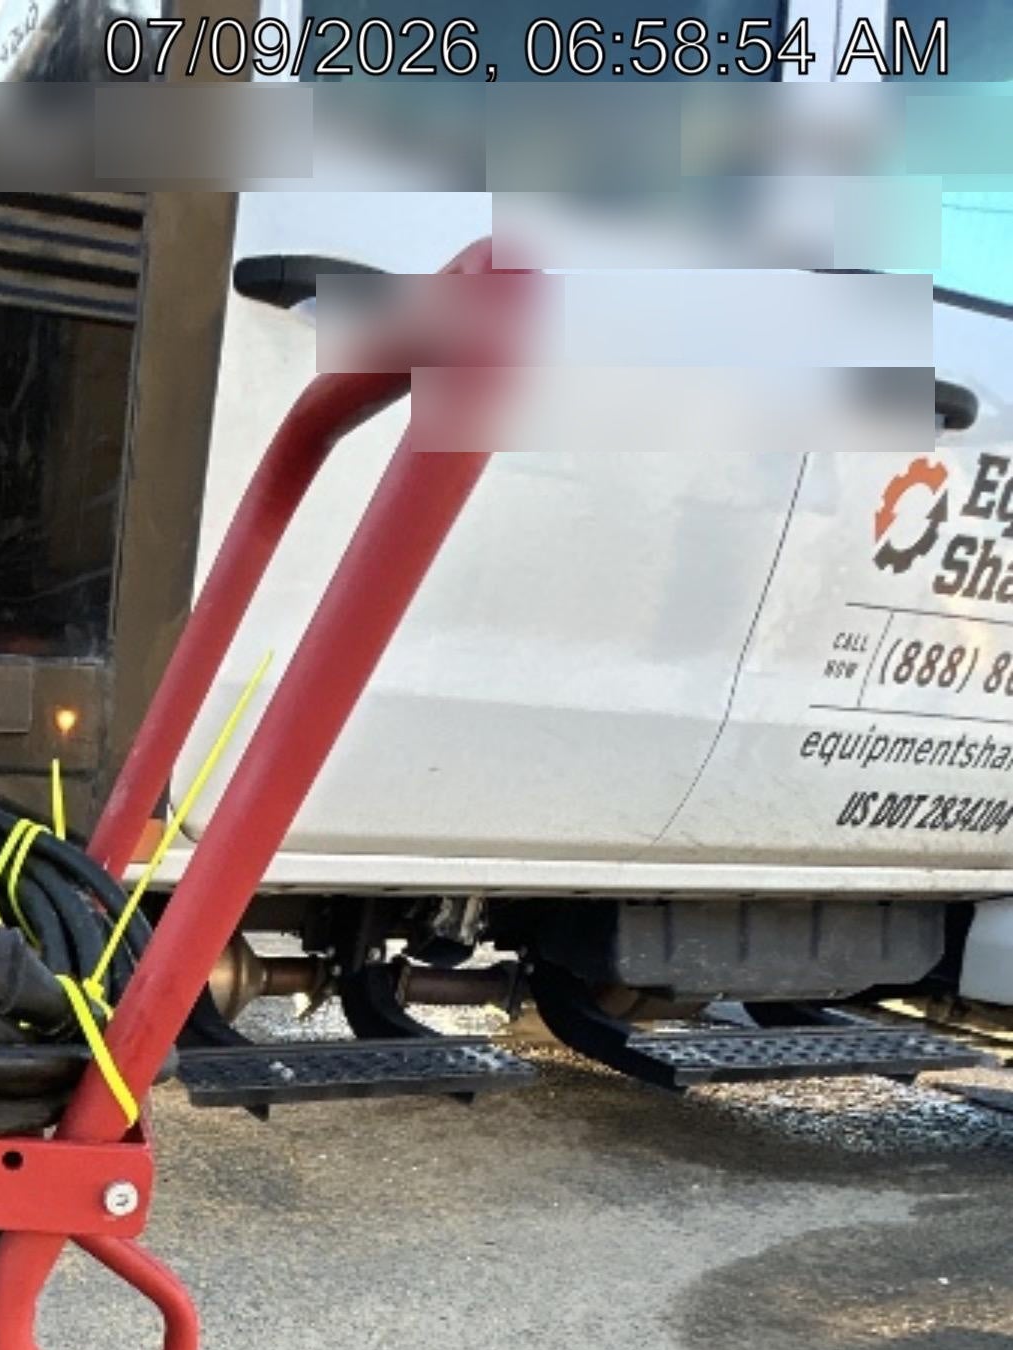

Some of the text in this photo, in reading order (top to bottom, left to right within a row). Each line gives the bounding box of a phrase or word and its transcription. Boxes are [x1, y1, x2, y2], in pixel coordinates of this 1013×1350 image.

[832, 632, 869, 653] CALL
[823, 659, 859, 680] NOW
[879, 638, 980, 694] (888)
[836, 791, 879, 827] US
[868, 793, 929, 829] DOT
